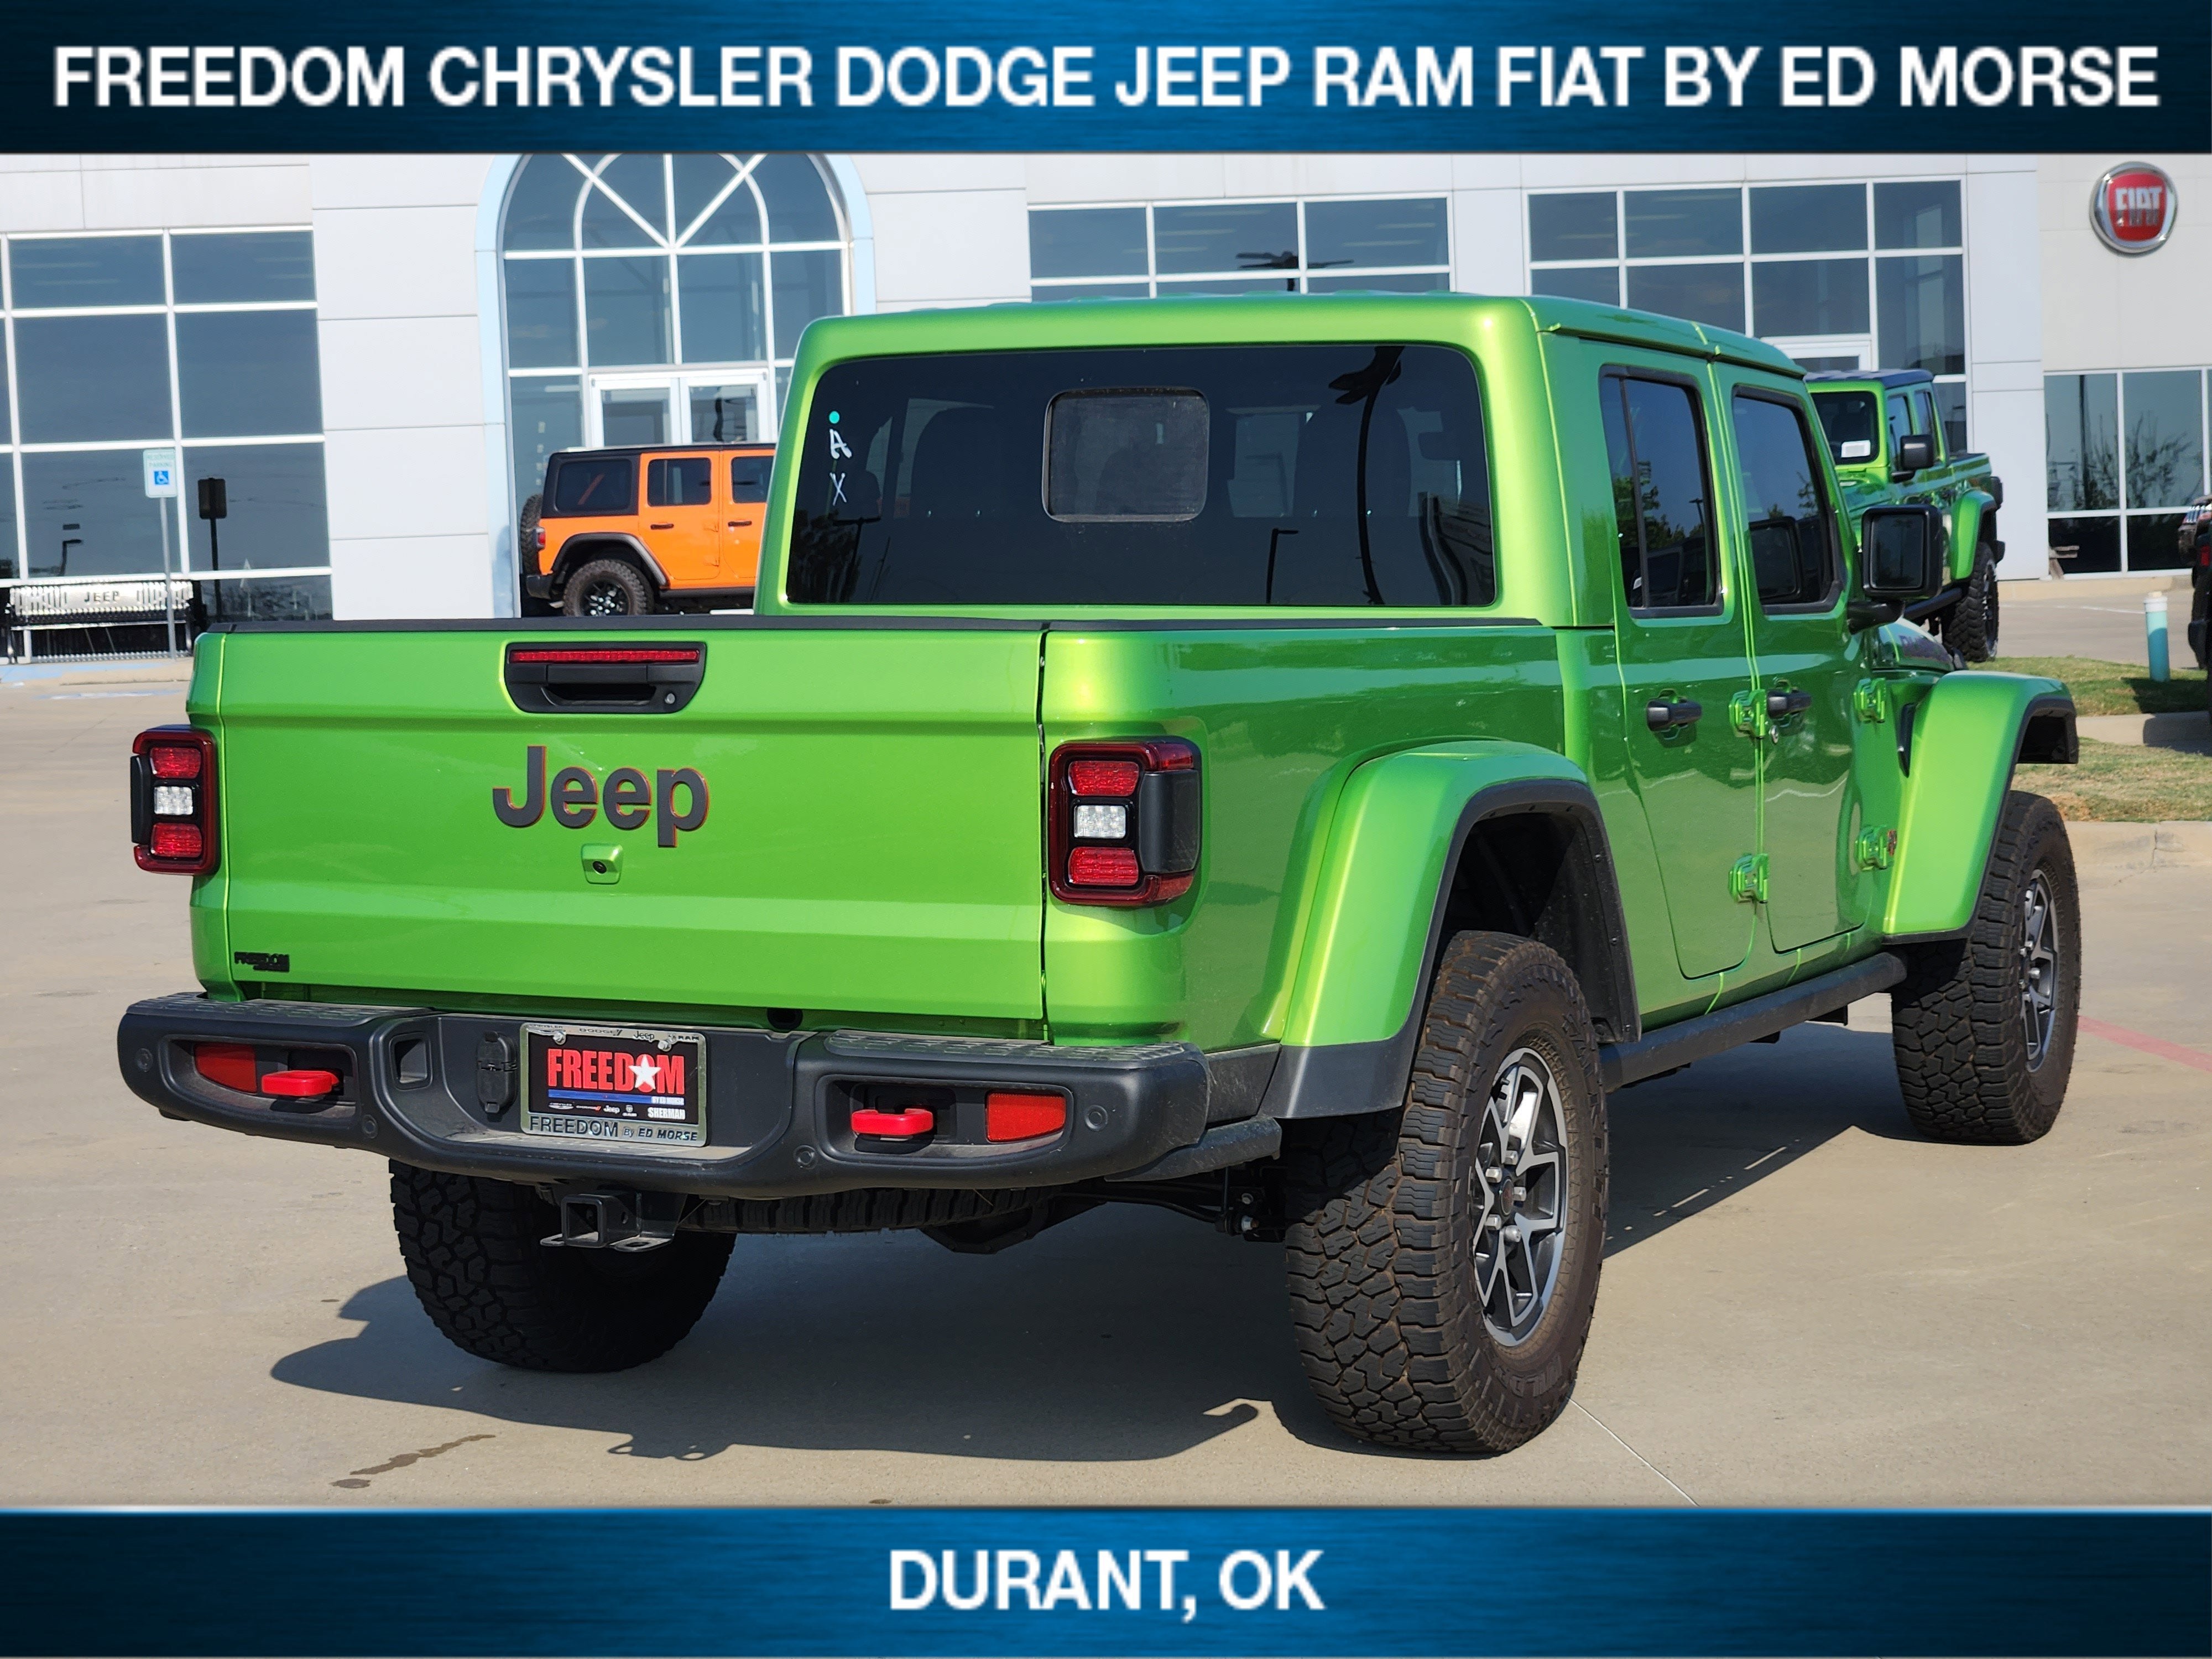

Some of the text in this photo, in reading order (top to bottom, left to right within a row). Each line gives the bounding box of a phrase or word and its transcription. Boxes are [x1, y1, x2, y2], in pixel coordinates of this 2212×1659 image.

[2114, 186, 2163, 227] FIAT
[829, 429, 853, 460] A
[829, 472, 848, 507] X
[84, 589, 120, 602] JEEP
[492, 745, 710, 848] Jeep
[633, 1030, 655, 1040] Jeep
[547, 1048, 685, 1095] FREEDOM
[603, 1105, 620, 1114] Jeep
[647, 1107, 686, 1120] SHERMAN
[529, 1116, 698, 1141] FREEDOM By ED MORSE
